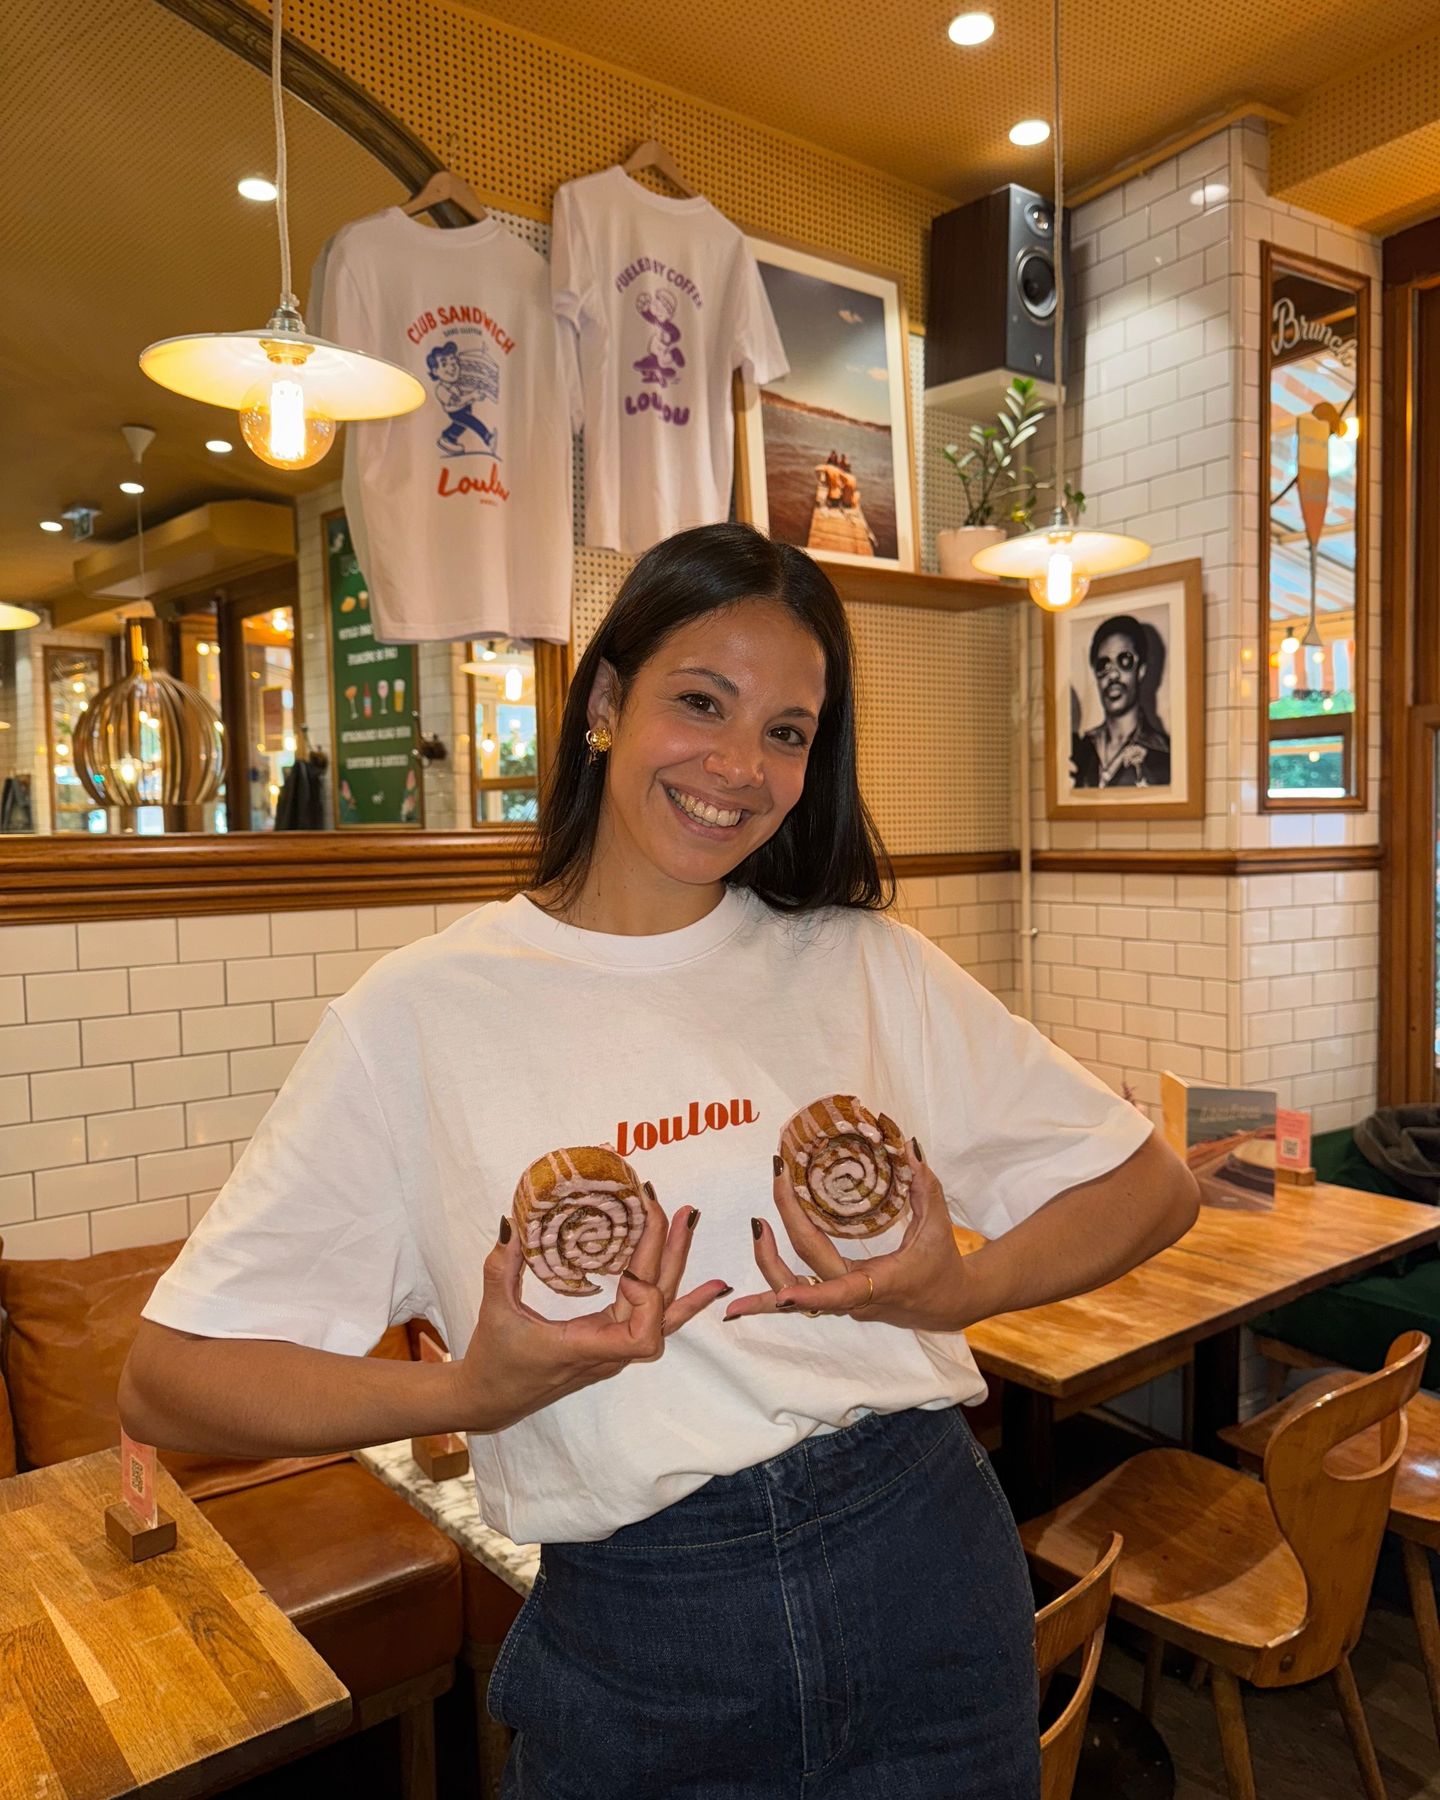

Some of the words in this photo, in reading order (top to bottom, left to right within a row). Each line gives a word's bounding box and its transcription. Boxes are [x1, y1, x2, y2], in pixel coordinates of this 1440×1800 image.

[407, 311, 438, 345] CLUB
[437, 305, 516, 355] SANDWICH
[1271, 297, 1358, 367] Brunch
[616, 1098, 760, 1157] loulou
